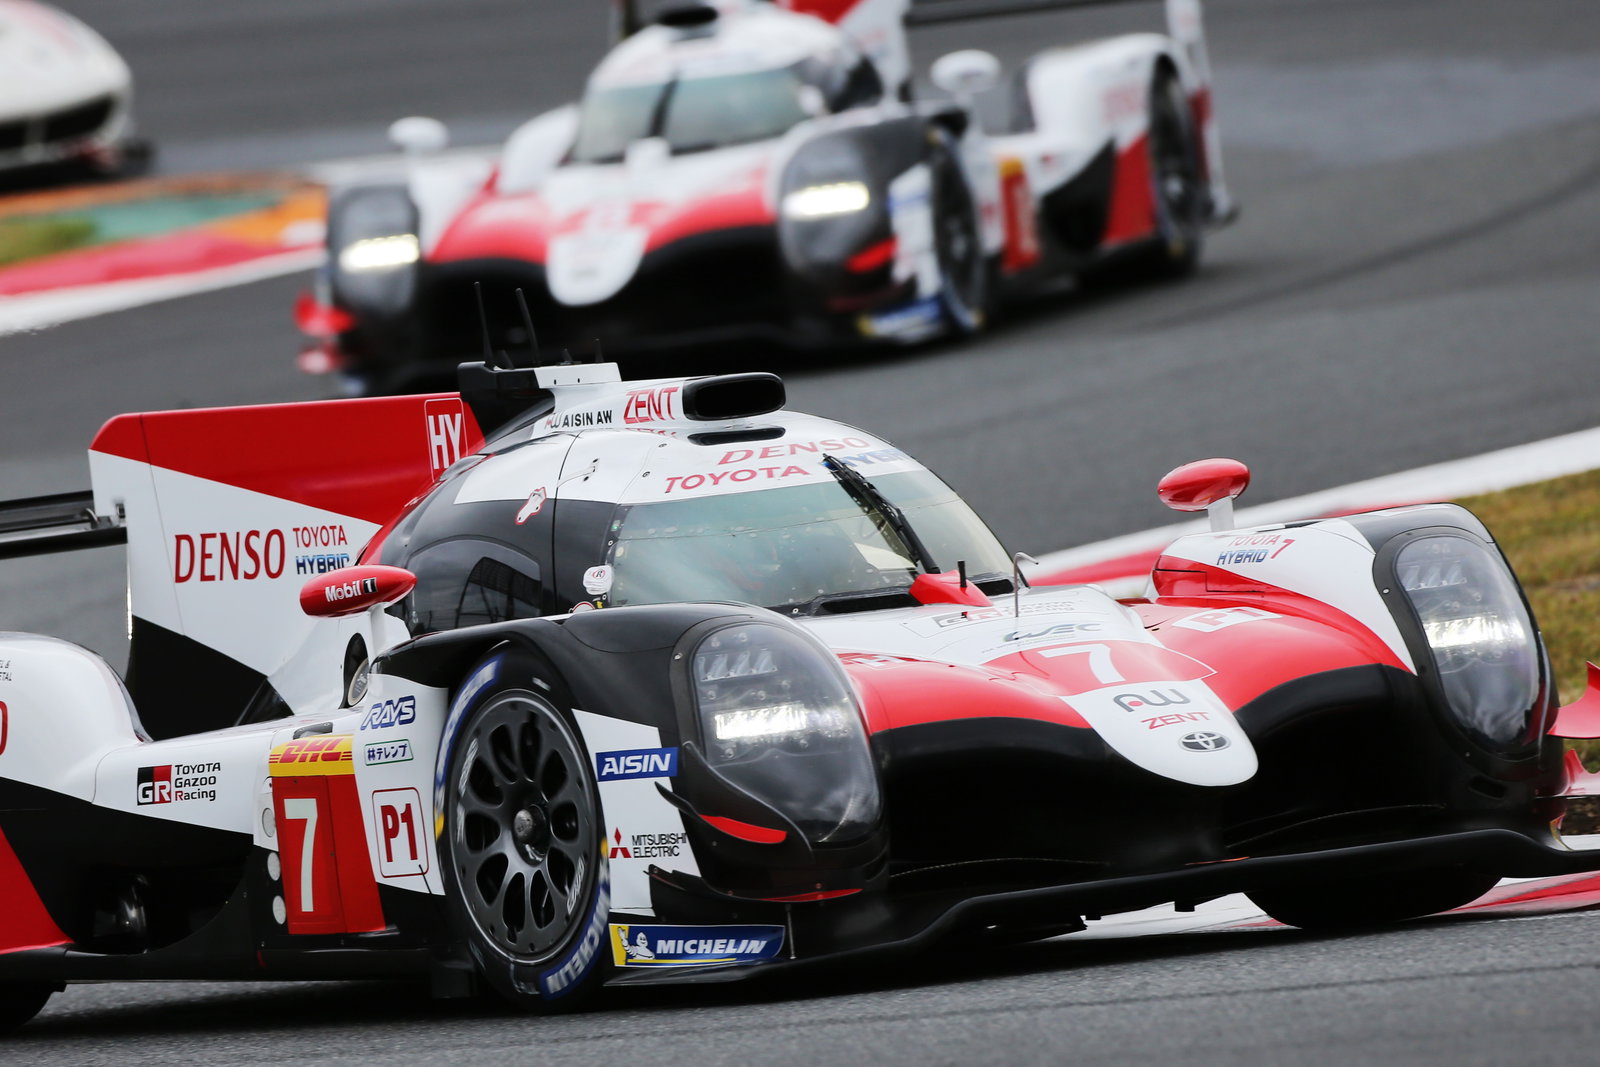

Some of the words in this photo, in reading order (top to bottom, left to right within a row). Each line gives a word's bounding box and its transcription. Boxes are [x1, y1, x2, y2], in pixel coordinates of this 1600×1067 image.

[623, 386, 680, 424] ZENT
[562, 412, 593, 429] AISIN
[596, 410, 613, 425] AW
[427, 412, 462, 469] HY
[717, 437, 871, 466] DENSO
[664, 465, 811, 494] TOYOTA
[292, 525, 348, 548] TOYOTA
[1228, 534, 1281, 547] TOYOTA
[174, 528, 286, 583] DENSO
[1216, 549, 1270, 566] HYBRID
[325, 580, 362, 603] Mobil
[1189, 608, 1265, 627] P1
[1036, 643, 1126, 685] 7
[360, 695, 416, 731] RAYS
[1140, 711, 1211, 730] ZENT
[279, 737, 345, 763] DHL
[367, 743, 408, 761] 林テレンプ
[601, 753, 671, 776] AISIN
[138, 780, 172, 803] GR
[174, 788, 216, 801] Racing
[380, 803, 418, 862] P1
[632, 832, 687, 846] MITSUBISHI
[284, 798, 318, 912] 7
[633, 845, 680, 858] ELECTRIC
[655, 939, 768, 954] MICHELIN
